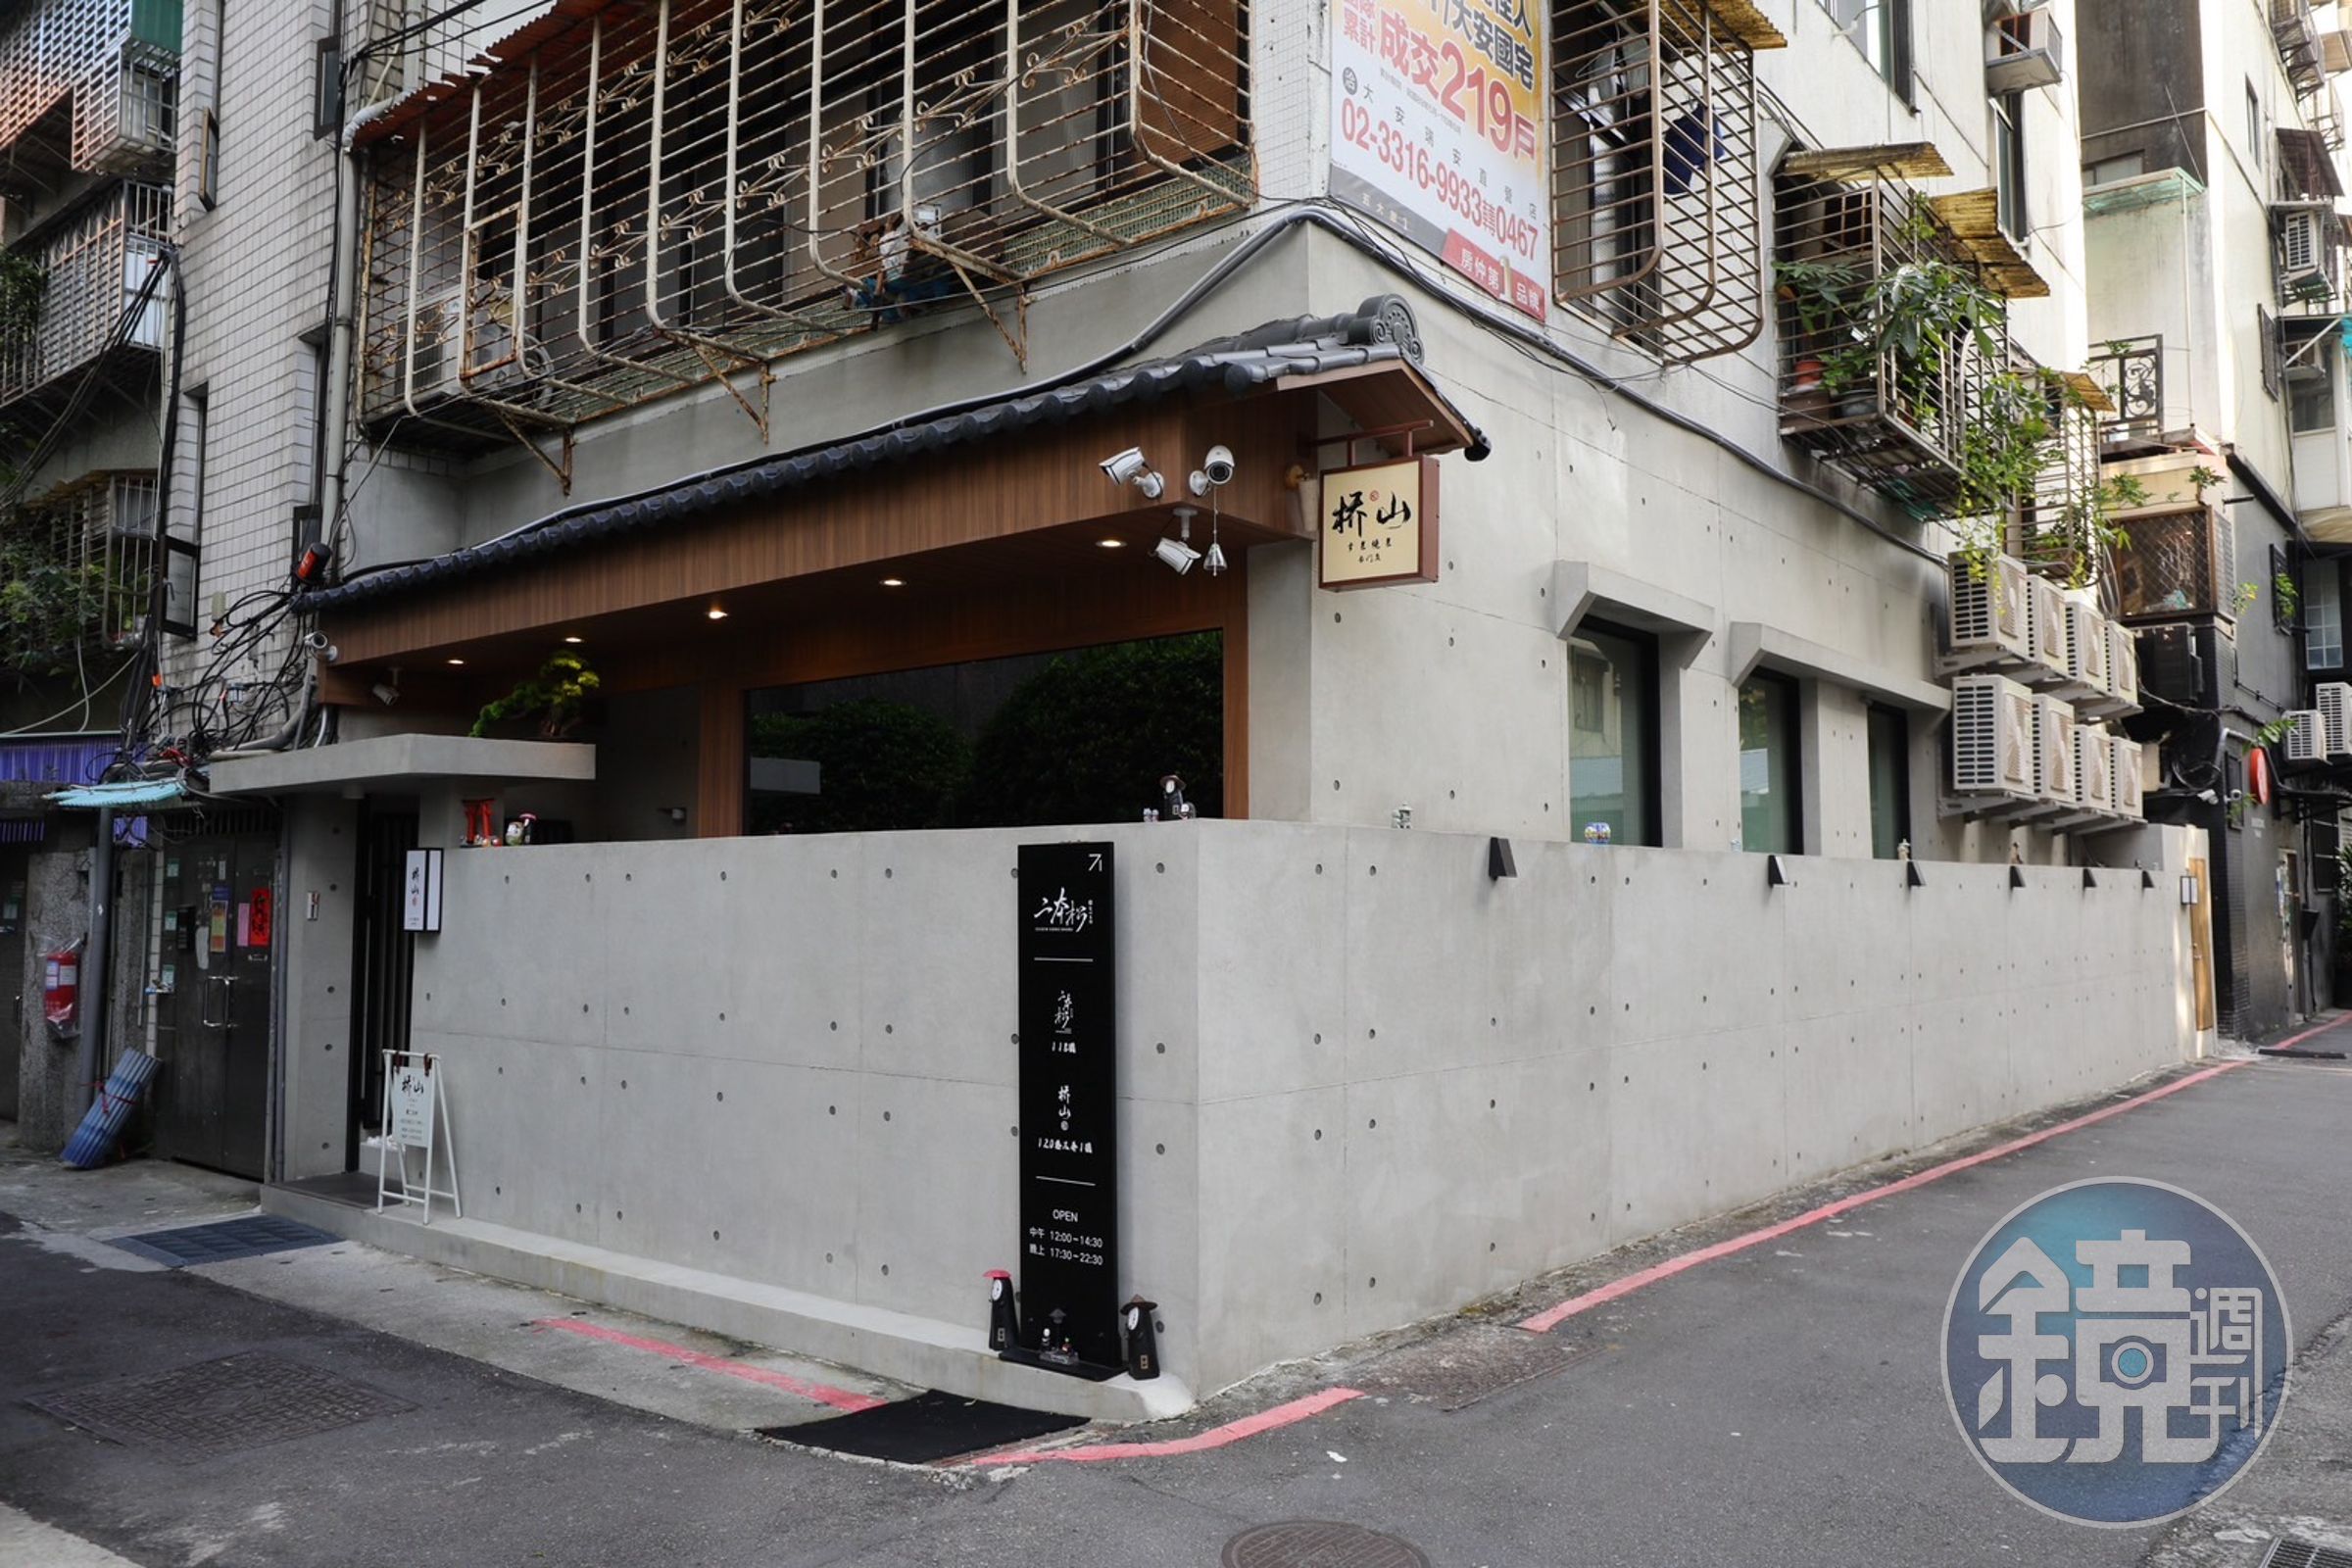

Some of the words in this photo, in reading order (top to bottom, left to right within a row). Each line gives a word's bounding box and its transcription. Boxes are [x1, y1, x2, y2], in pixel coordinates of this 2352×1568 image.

[1380, 11, 1535, 160] 成交219戶
[1053, 1208, 1079, 1222] OPEN
[1029, 1226, 1045, 1239] 中午
